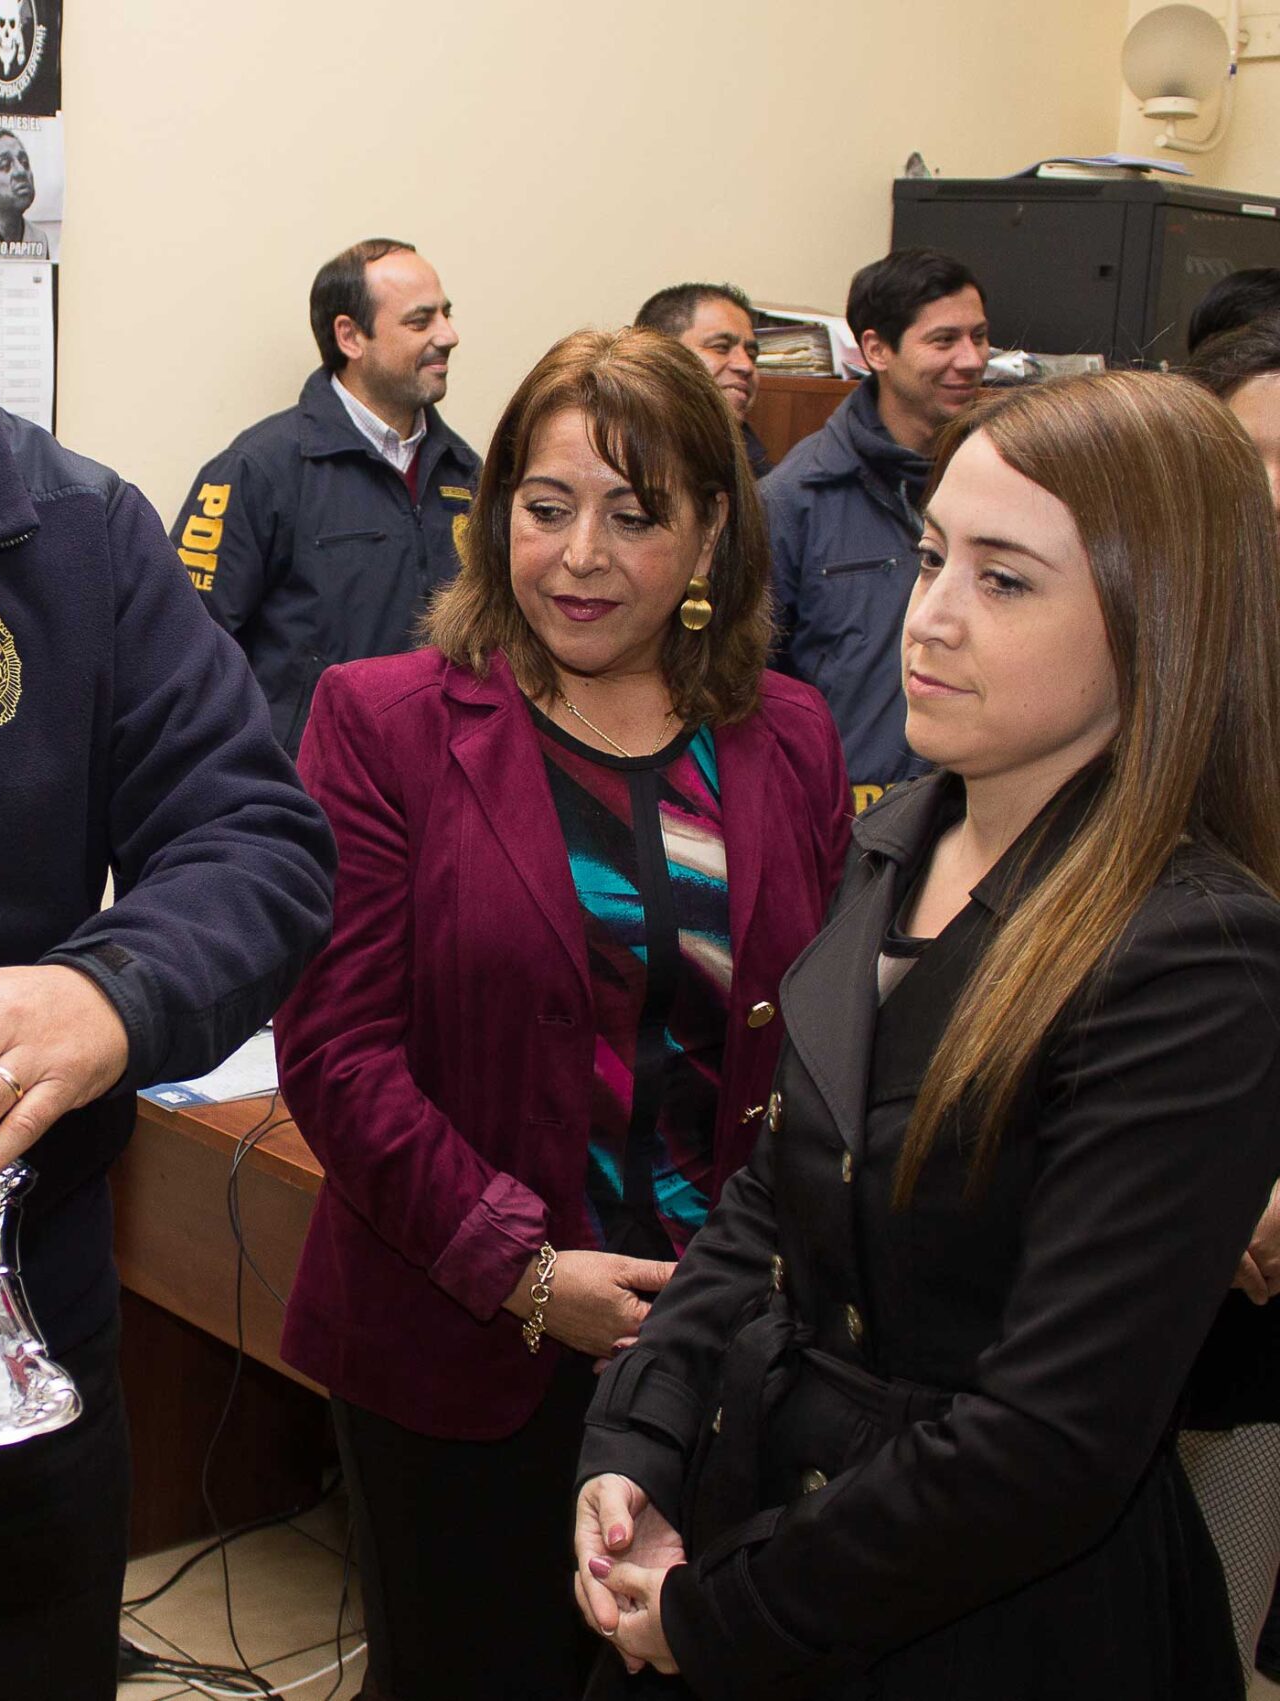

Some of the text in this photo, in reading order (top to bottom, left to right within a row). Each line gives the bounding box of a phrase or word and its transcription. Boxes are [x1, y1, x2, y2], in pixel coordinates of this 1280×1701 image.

[17, 116, 28, 131] ES
[9, 241, 43, 255] PAPITO
[177, 483, 231, 572] PDI
